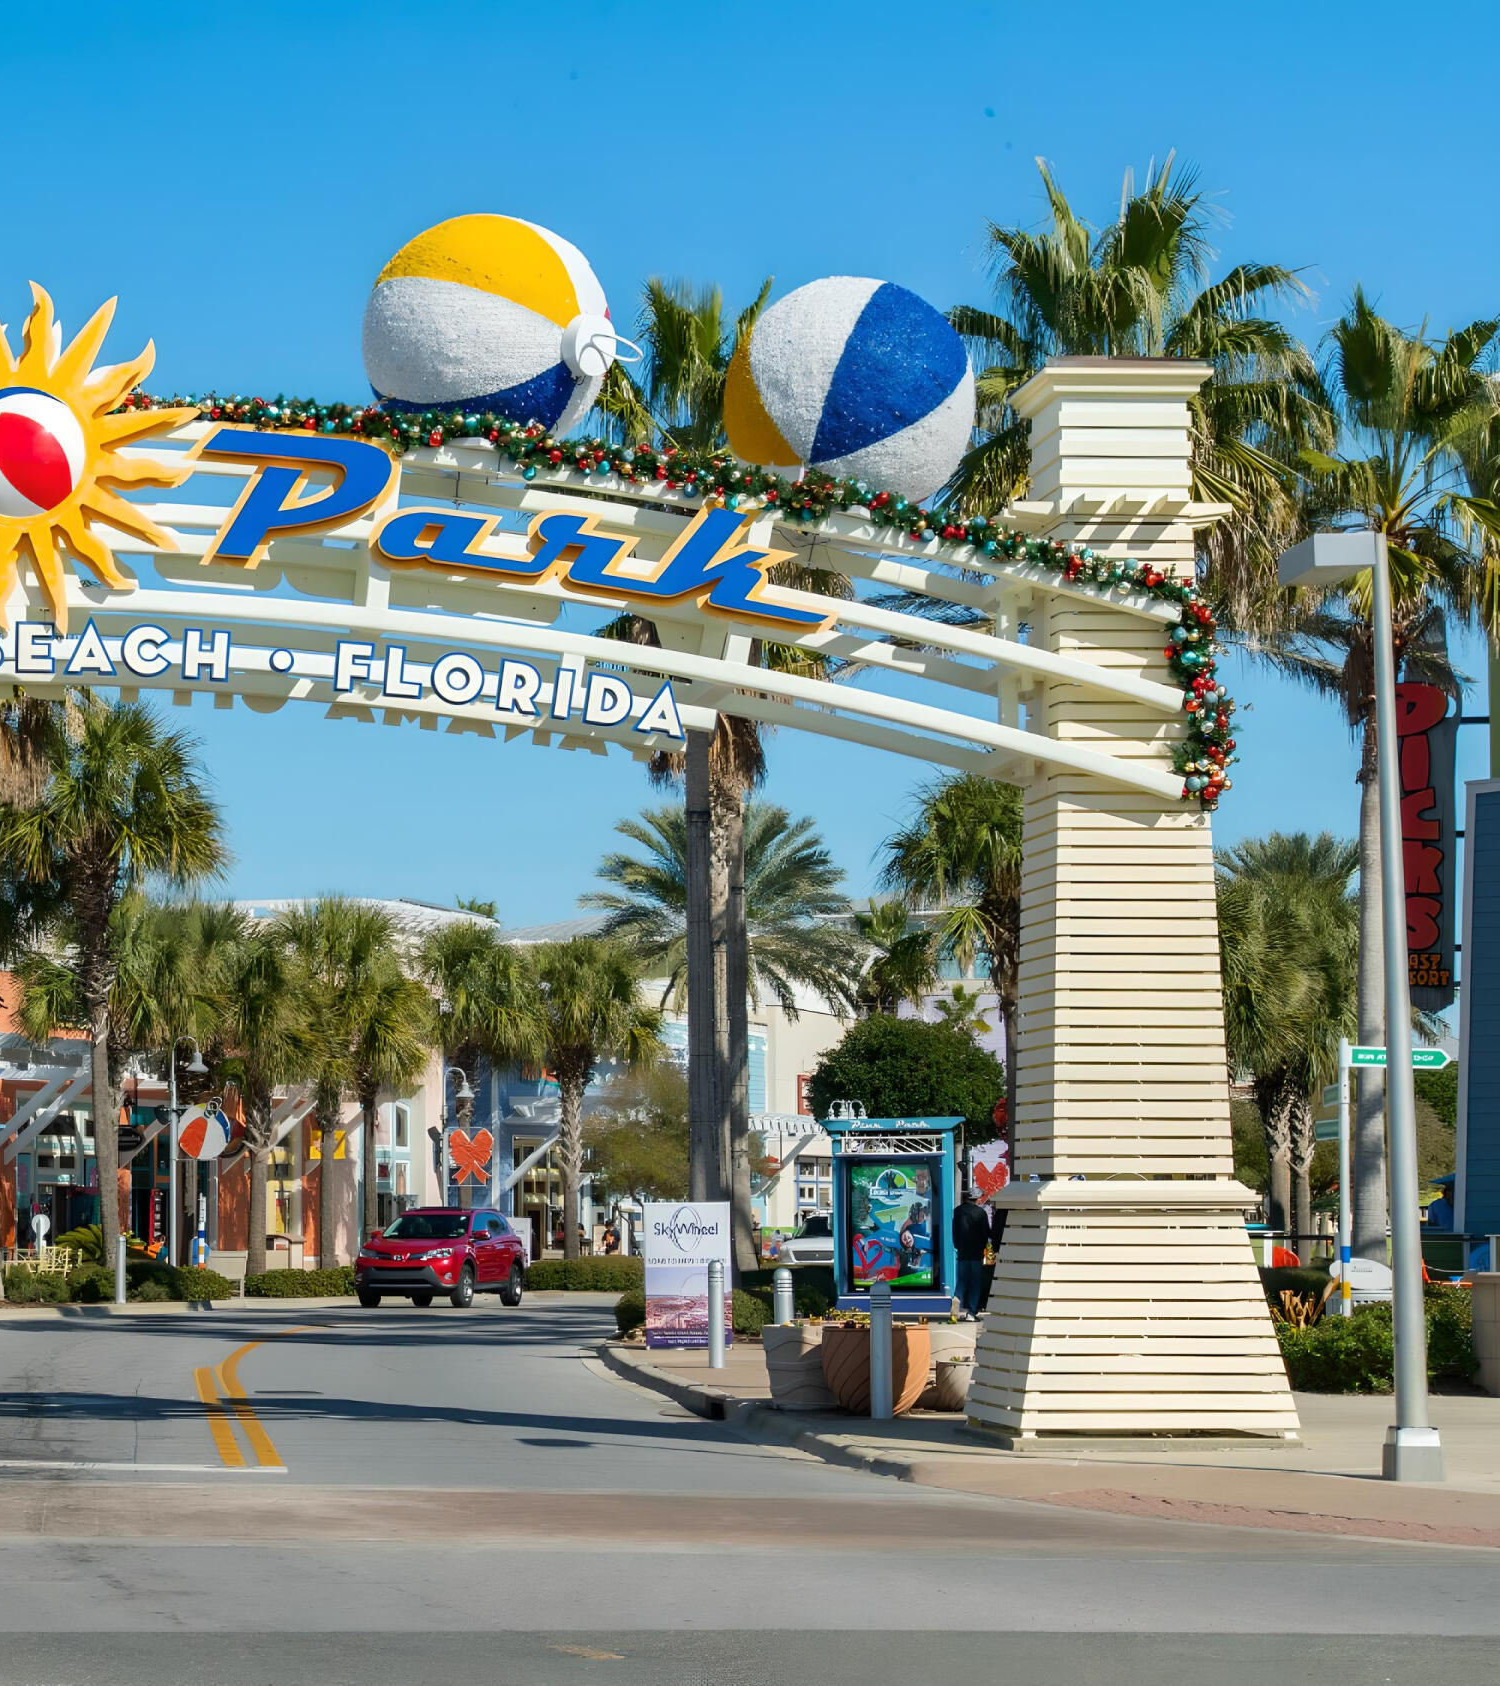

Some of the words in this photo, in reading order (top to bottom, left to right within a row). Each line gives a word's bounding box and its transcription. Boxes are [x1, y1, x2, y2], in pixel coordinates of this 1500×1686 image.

[186, 421, 840, 634] Park
[332, 640, 687, 740] FLORIDA
[1408, 952, 1442, 970] AST
